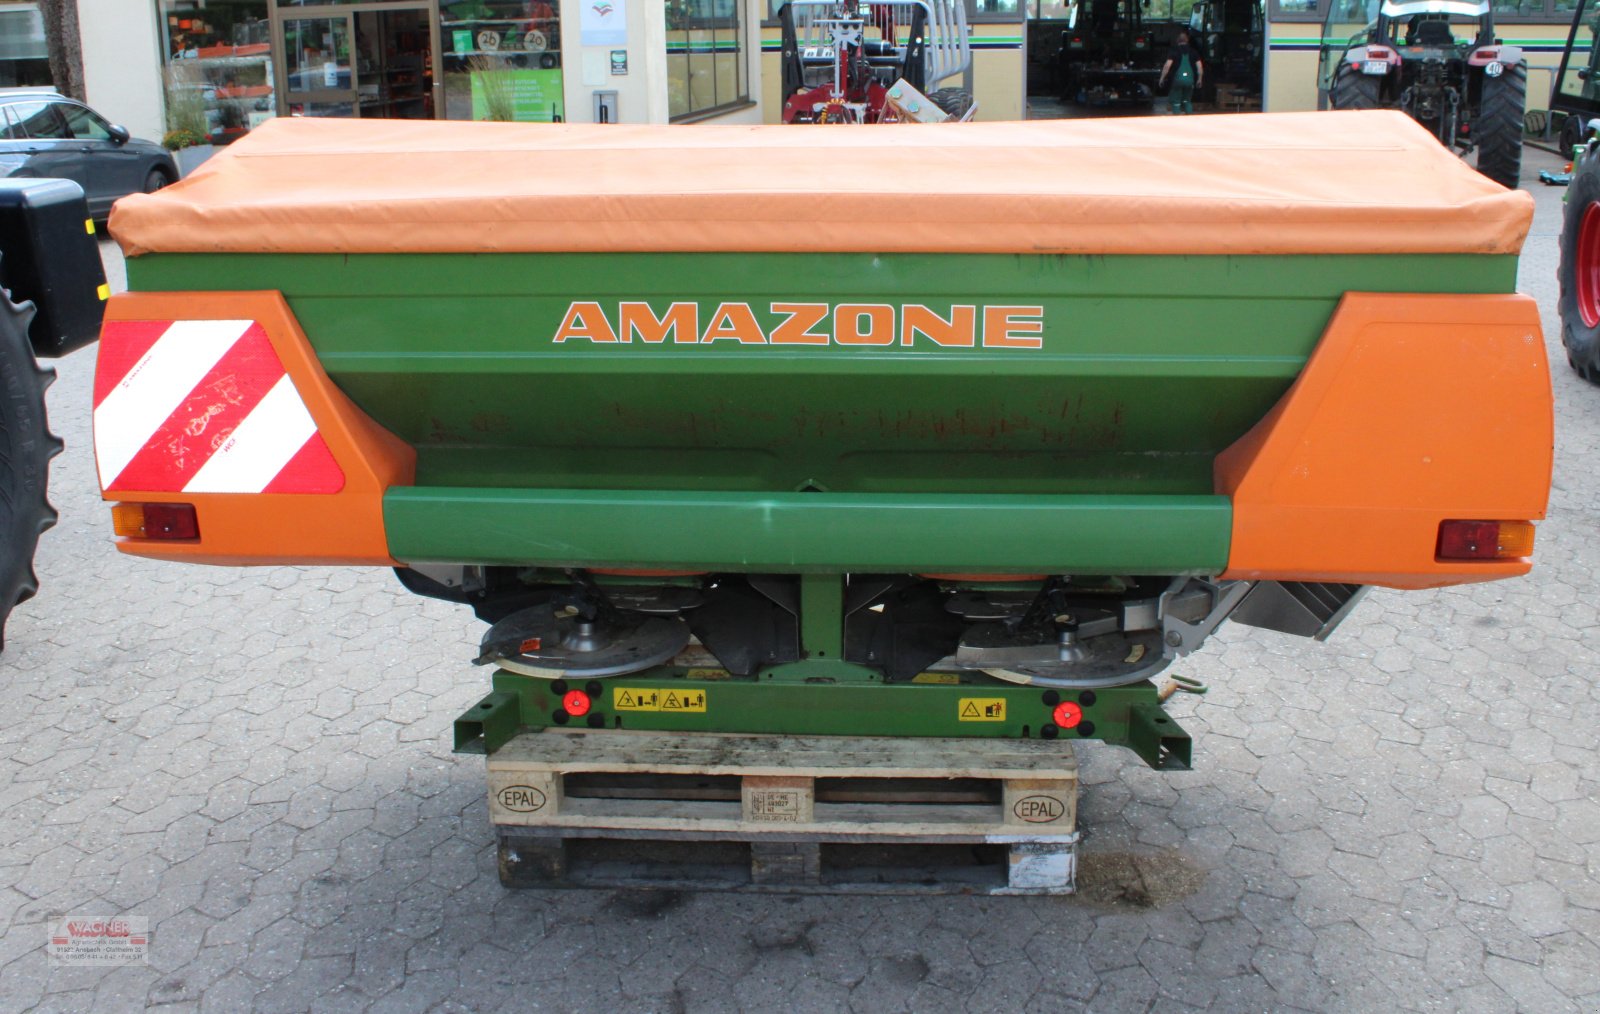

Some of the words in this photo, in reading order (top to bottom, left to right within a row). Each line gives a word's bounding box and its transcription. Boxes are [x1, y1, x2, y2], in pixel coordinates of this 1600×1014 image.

[1488, 63, 1501, 75] 40
[552, 300, 1045, 349] AMAZONE
[504, 791, 539, 807] EPAL
[1021, 801, 1057, 817] EPAL
